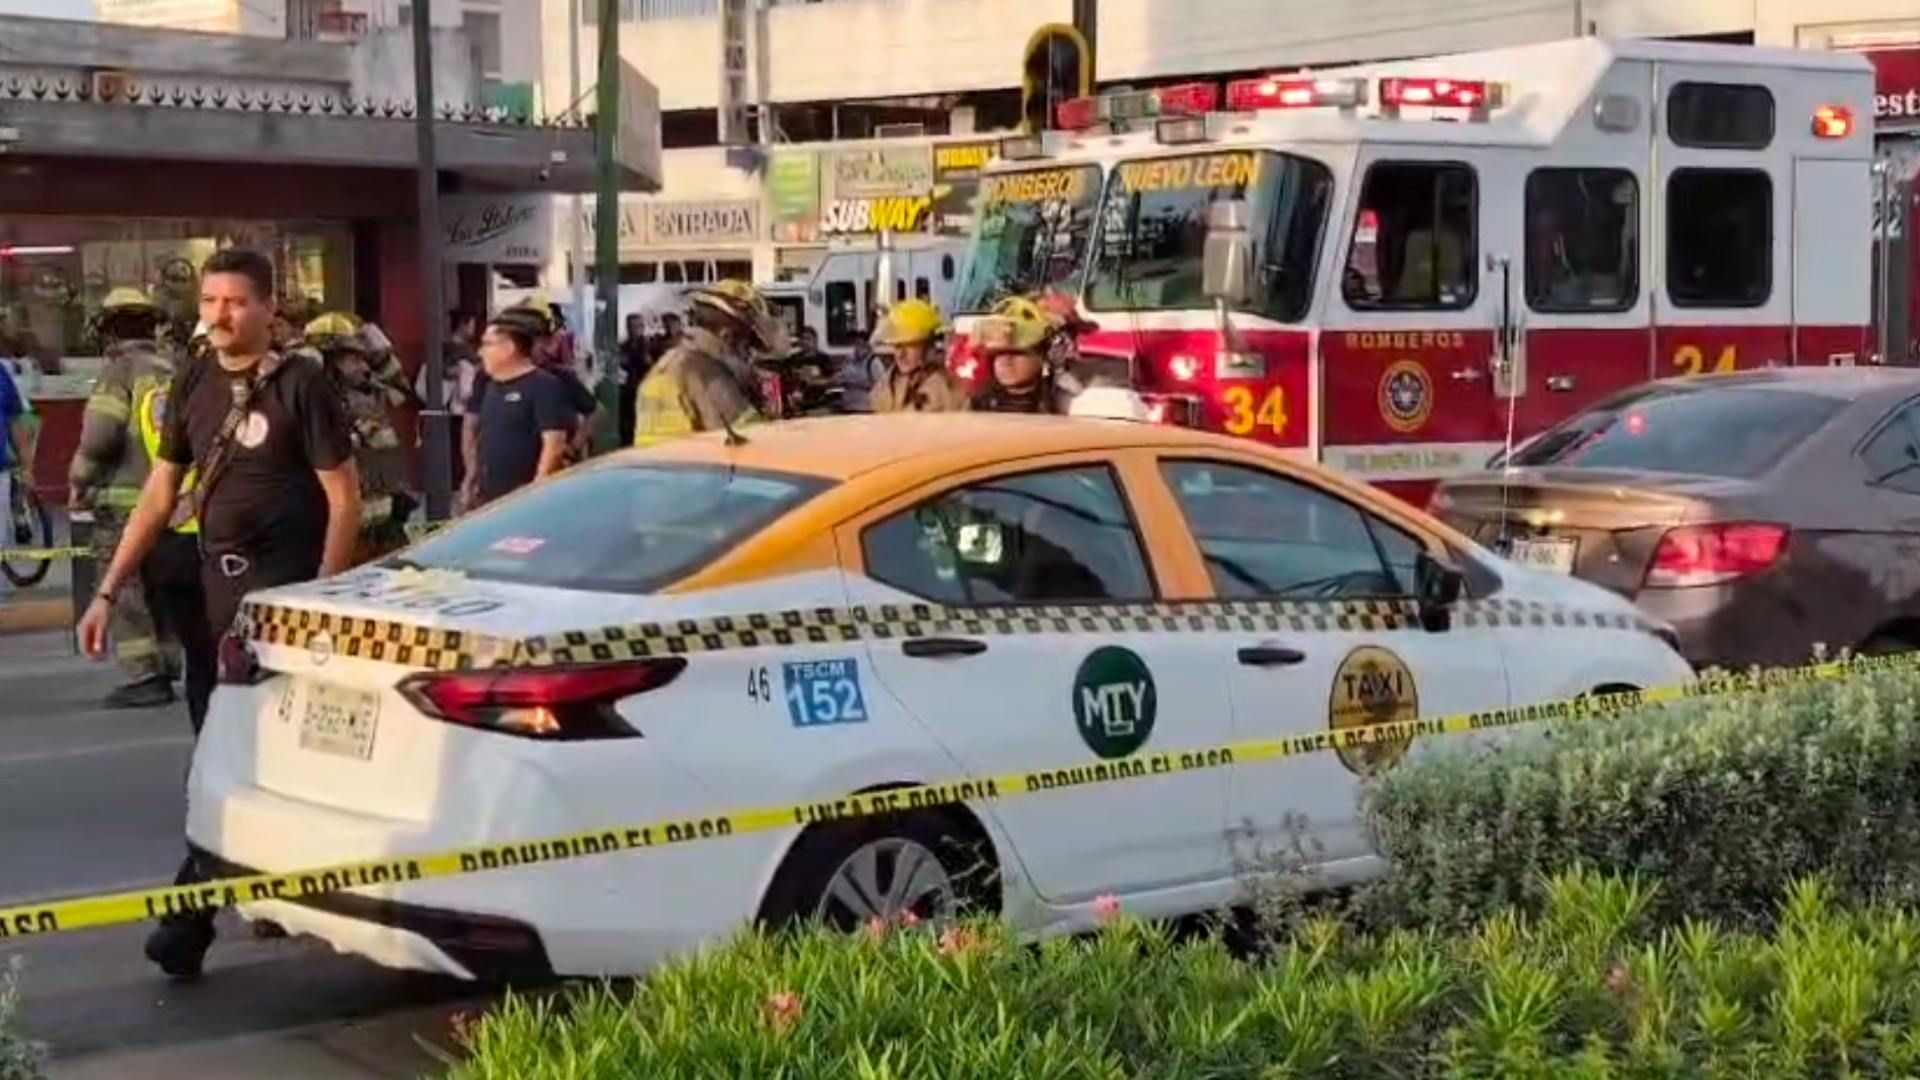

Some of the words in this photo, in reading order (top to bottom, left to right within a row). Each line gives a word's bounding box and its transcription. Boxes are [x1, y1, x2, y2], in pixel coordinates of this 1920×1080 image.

[1120, 158, 1192, 192] NUEVO
[654, 208, 752, 236] ENTRADA
[821, 196, 933, 233] SUBWAY
[1345, 331, 1465, 349] BOMBEROS
[1223, 385, 1288, 435] 34
[748, 666, 770, 703] 46
[792, 661, 846, 679] TSCM
[1343, 669, 1404, 701] TAXI
[787, 678, 864, 724] 152
[1081, 679, 1147, 737] MTY
